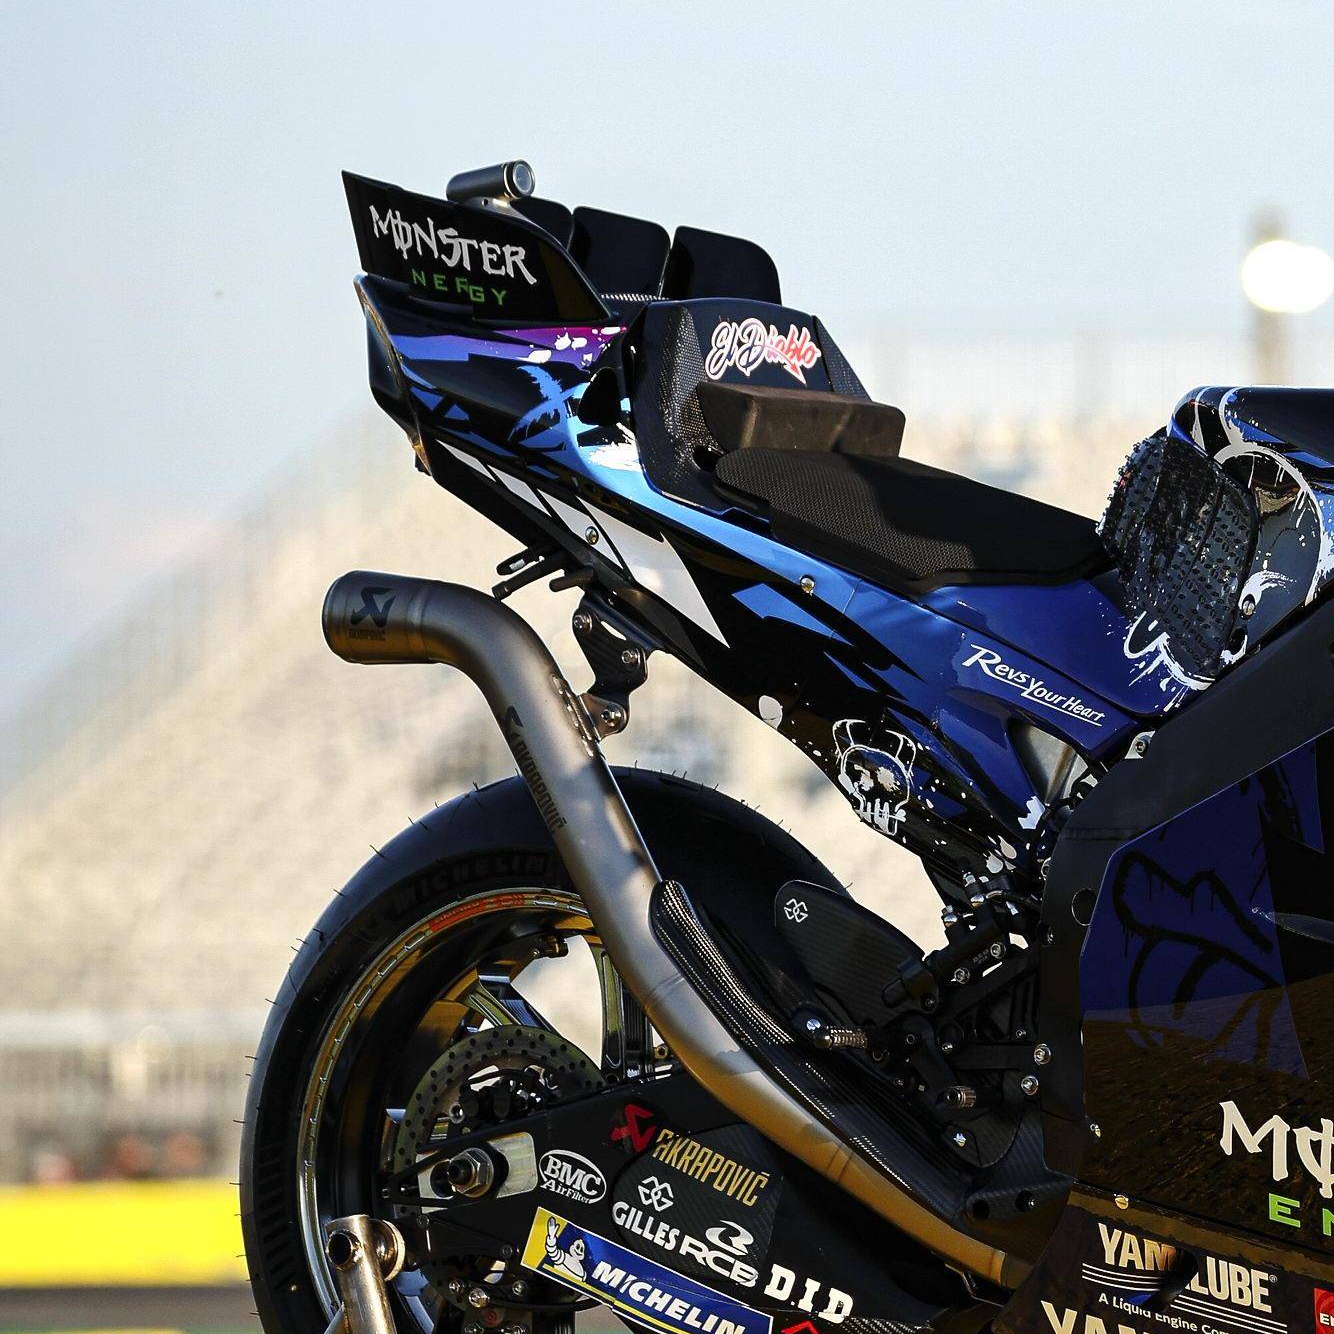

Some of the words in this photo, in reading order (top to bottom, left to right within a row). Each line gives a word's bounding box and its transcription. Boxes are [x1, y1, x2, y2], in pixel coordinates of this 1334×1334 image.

[369, 205, 537, 285] MONSTER
[962, 643, 1031, 684] Revs
[1021, 677, 1067, 705] Your
[1061, 696, 1106, 722] Heart
[544, 1155, 601, 1197] BMC
[612, 1201, 681, 1251] GILLES
[678, 1234, 759, 1288] RCB
[1097, 1222, 1273, 1314] YAMLUBE
[1098, 1292, 1109, 1304] A
